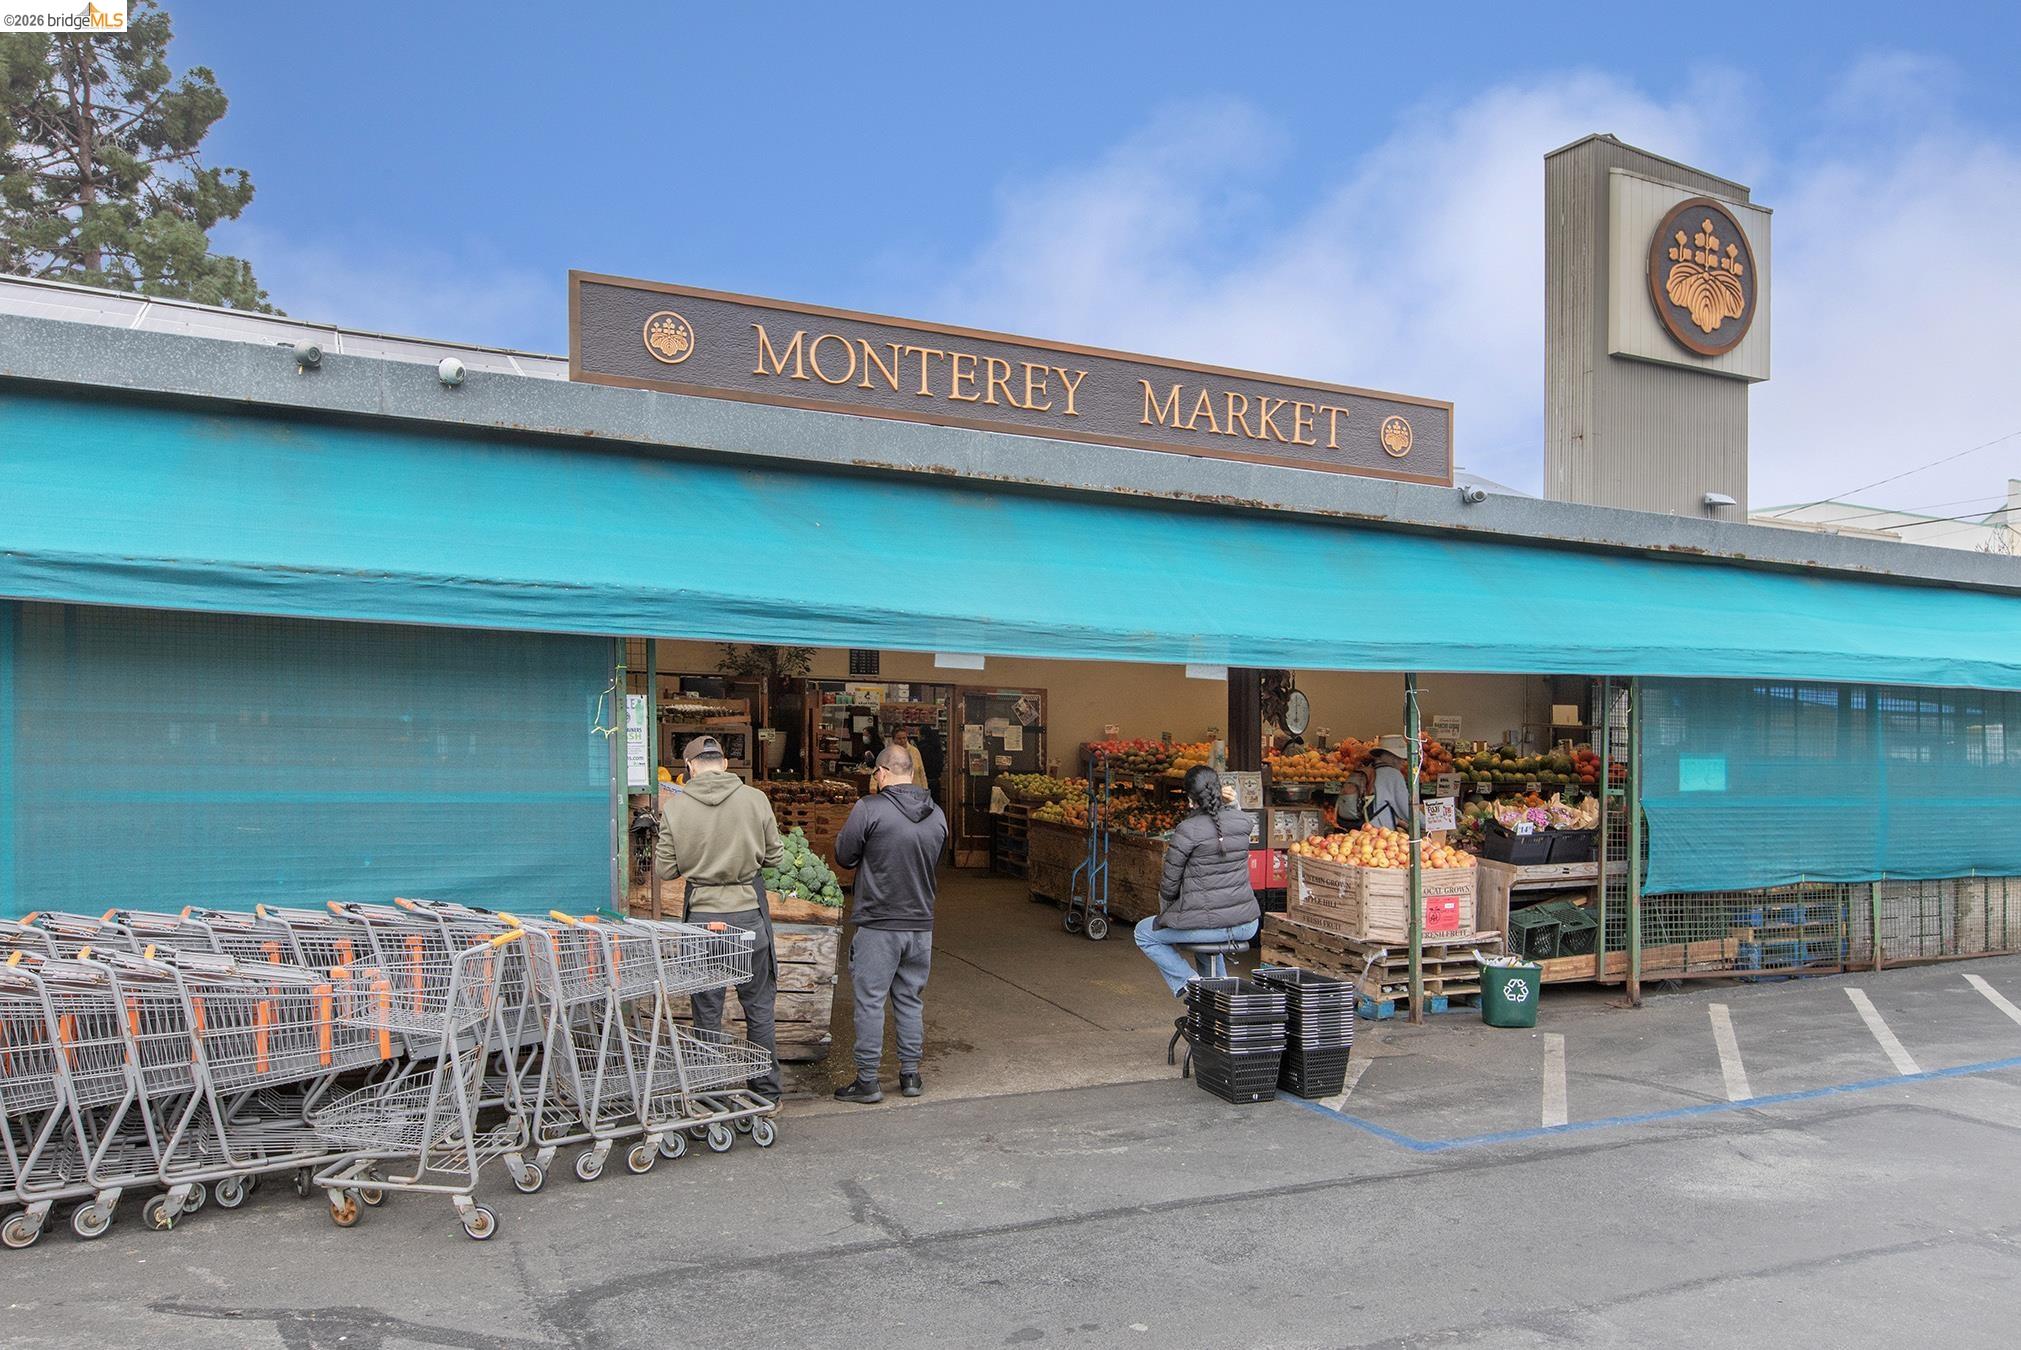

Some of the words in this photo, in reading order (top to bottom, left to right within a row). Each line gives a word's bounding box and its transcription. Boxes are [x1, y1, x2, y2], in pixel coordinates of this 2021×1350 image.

[750, 323, 1088, 416] MONTEREY
[1138, 379, 1349, 449] MARKET
[1423, 887, 1443, 895] OCAL
[1444, 885, 1471, 894] GROWN
